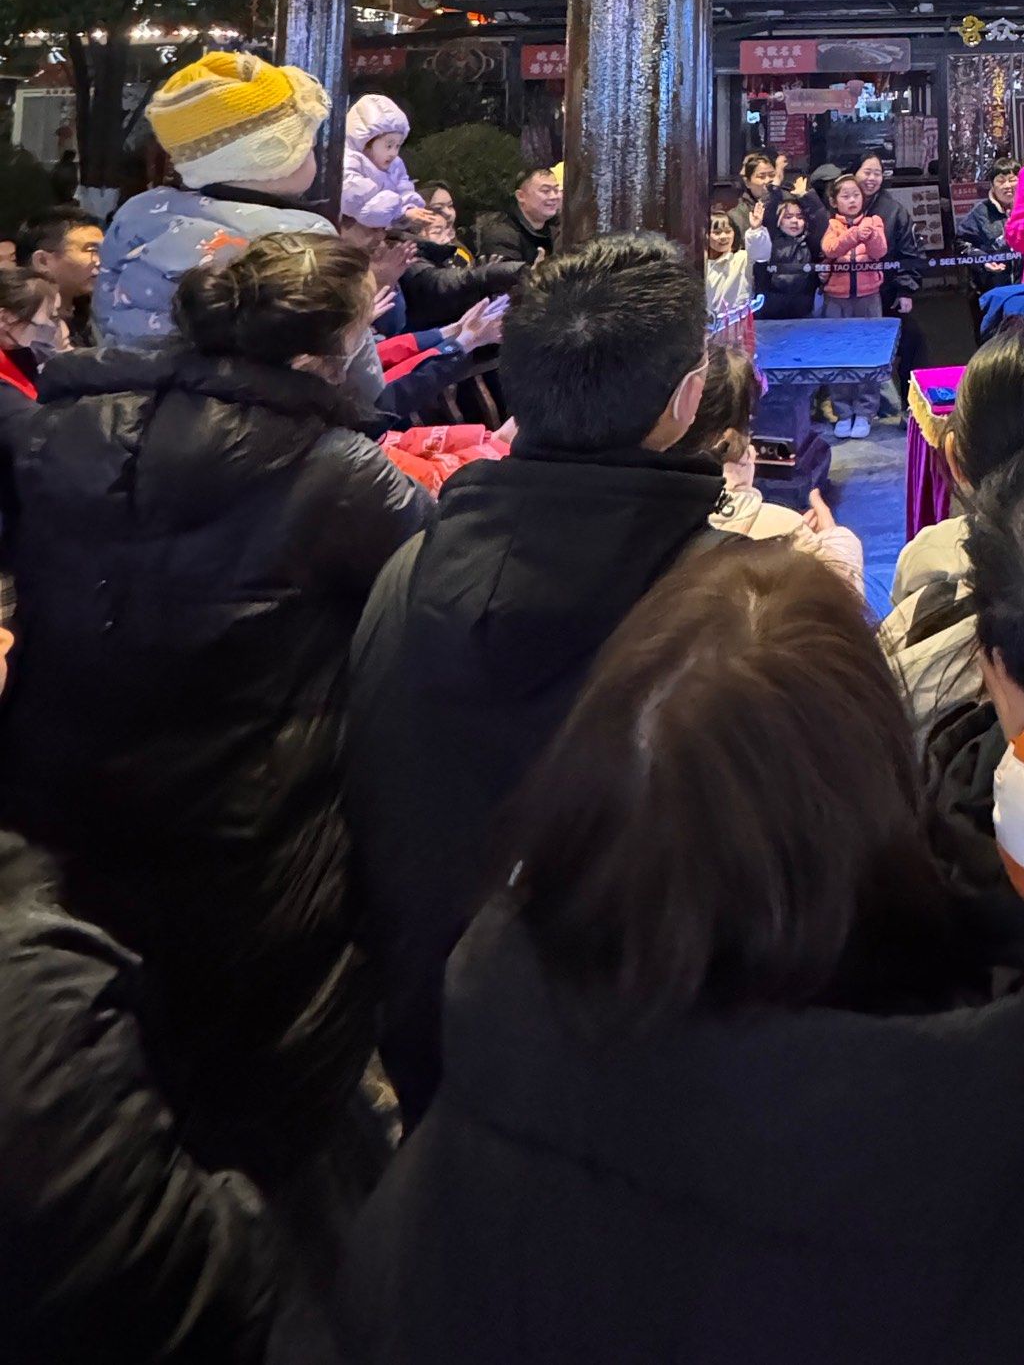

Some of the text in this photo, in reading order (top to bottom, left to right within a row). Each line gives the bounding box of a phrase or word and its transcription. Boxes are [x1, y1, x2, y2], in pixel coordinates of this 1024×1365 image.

[939, 251, 1022, 266] SEE TAO LOUNGE BAR
[814, 260, 901, 272] SEE TAO LOUNGE BAR
